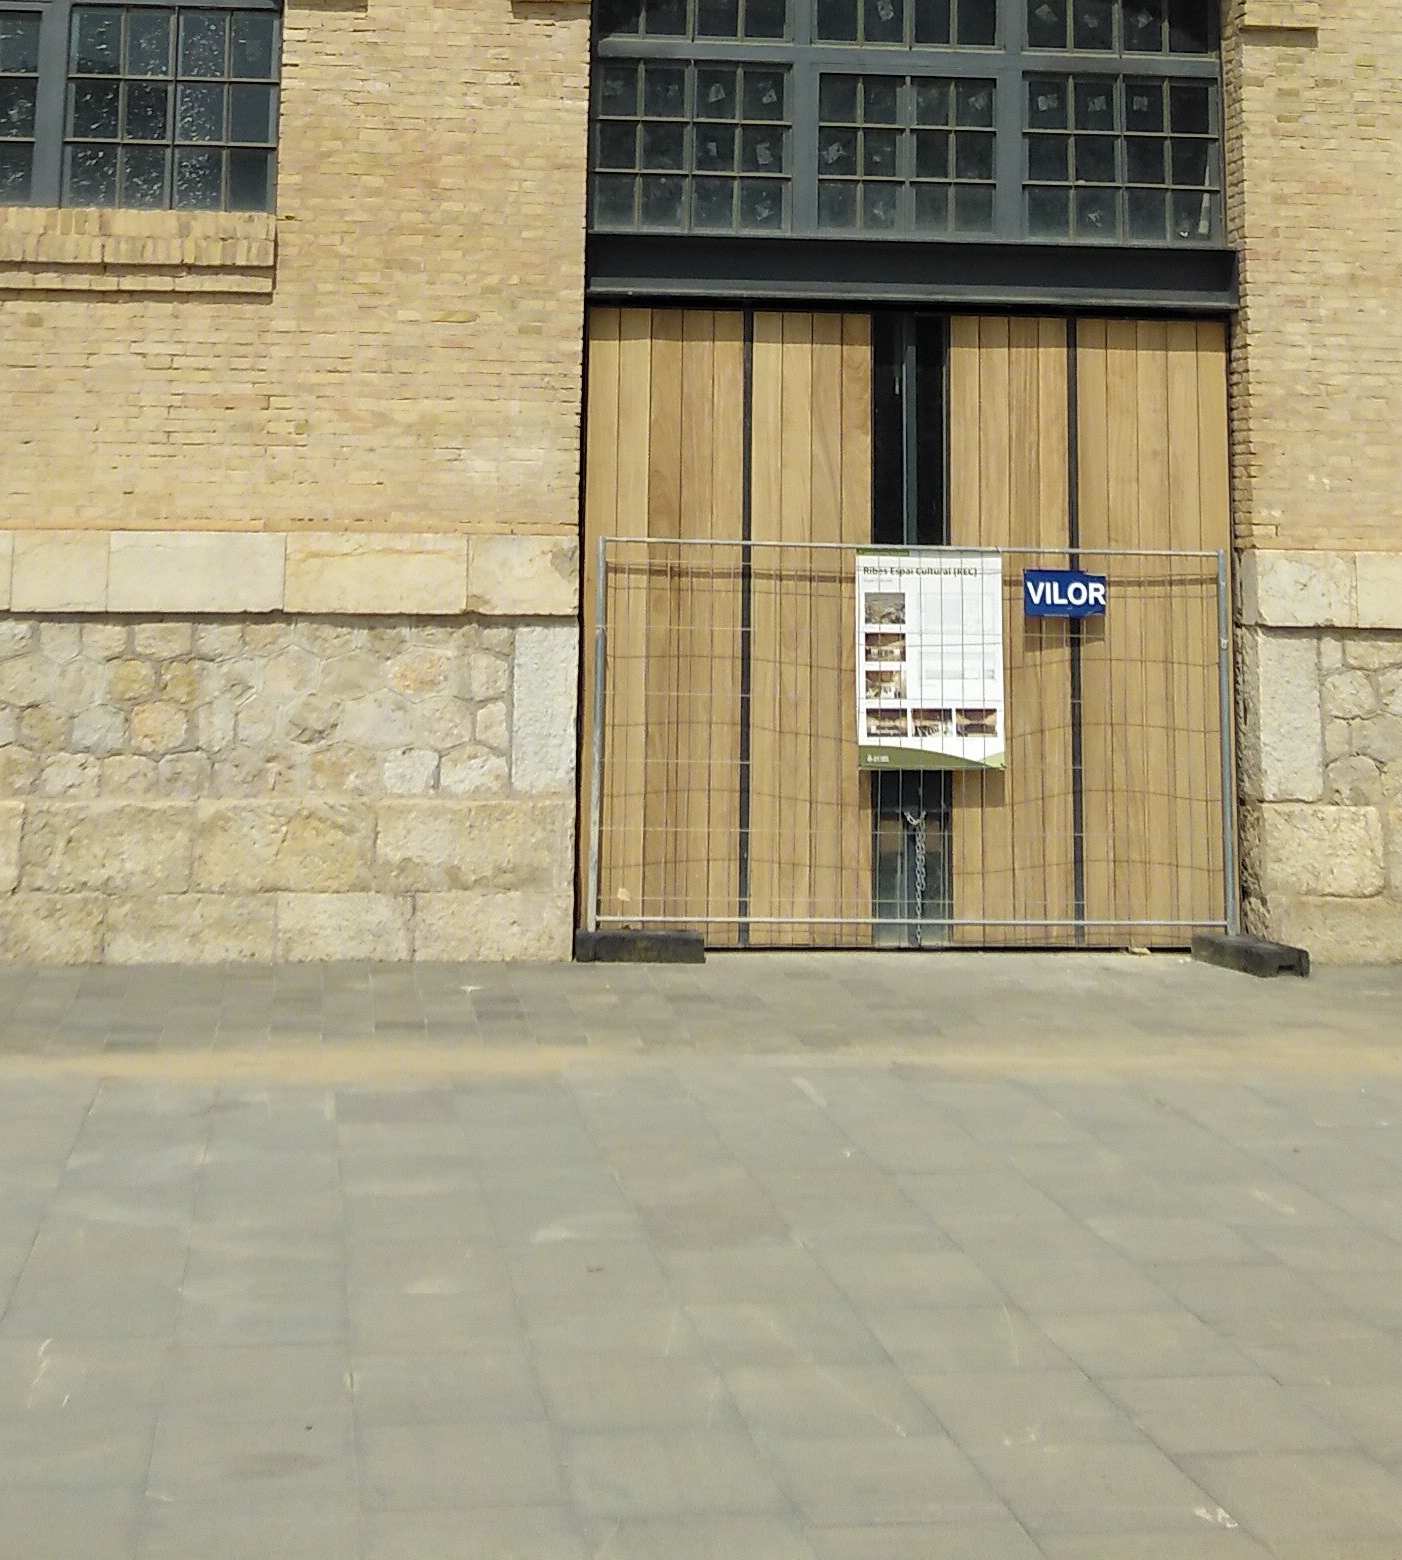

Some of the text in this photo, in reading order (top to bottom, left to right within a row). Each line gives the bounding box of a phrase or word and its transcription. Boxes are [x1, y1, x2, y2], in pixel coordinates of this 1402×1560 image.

[863, 567, 888, 575] Ribes
[890, 567, 914, 577] Espai
[915, 567, 951, 576] Cultural
[1026, 581, 1107, 606] VILOR
